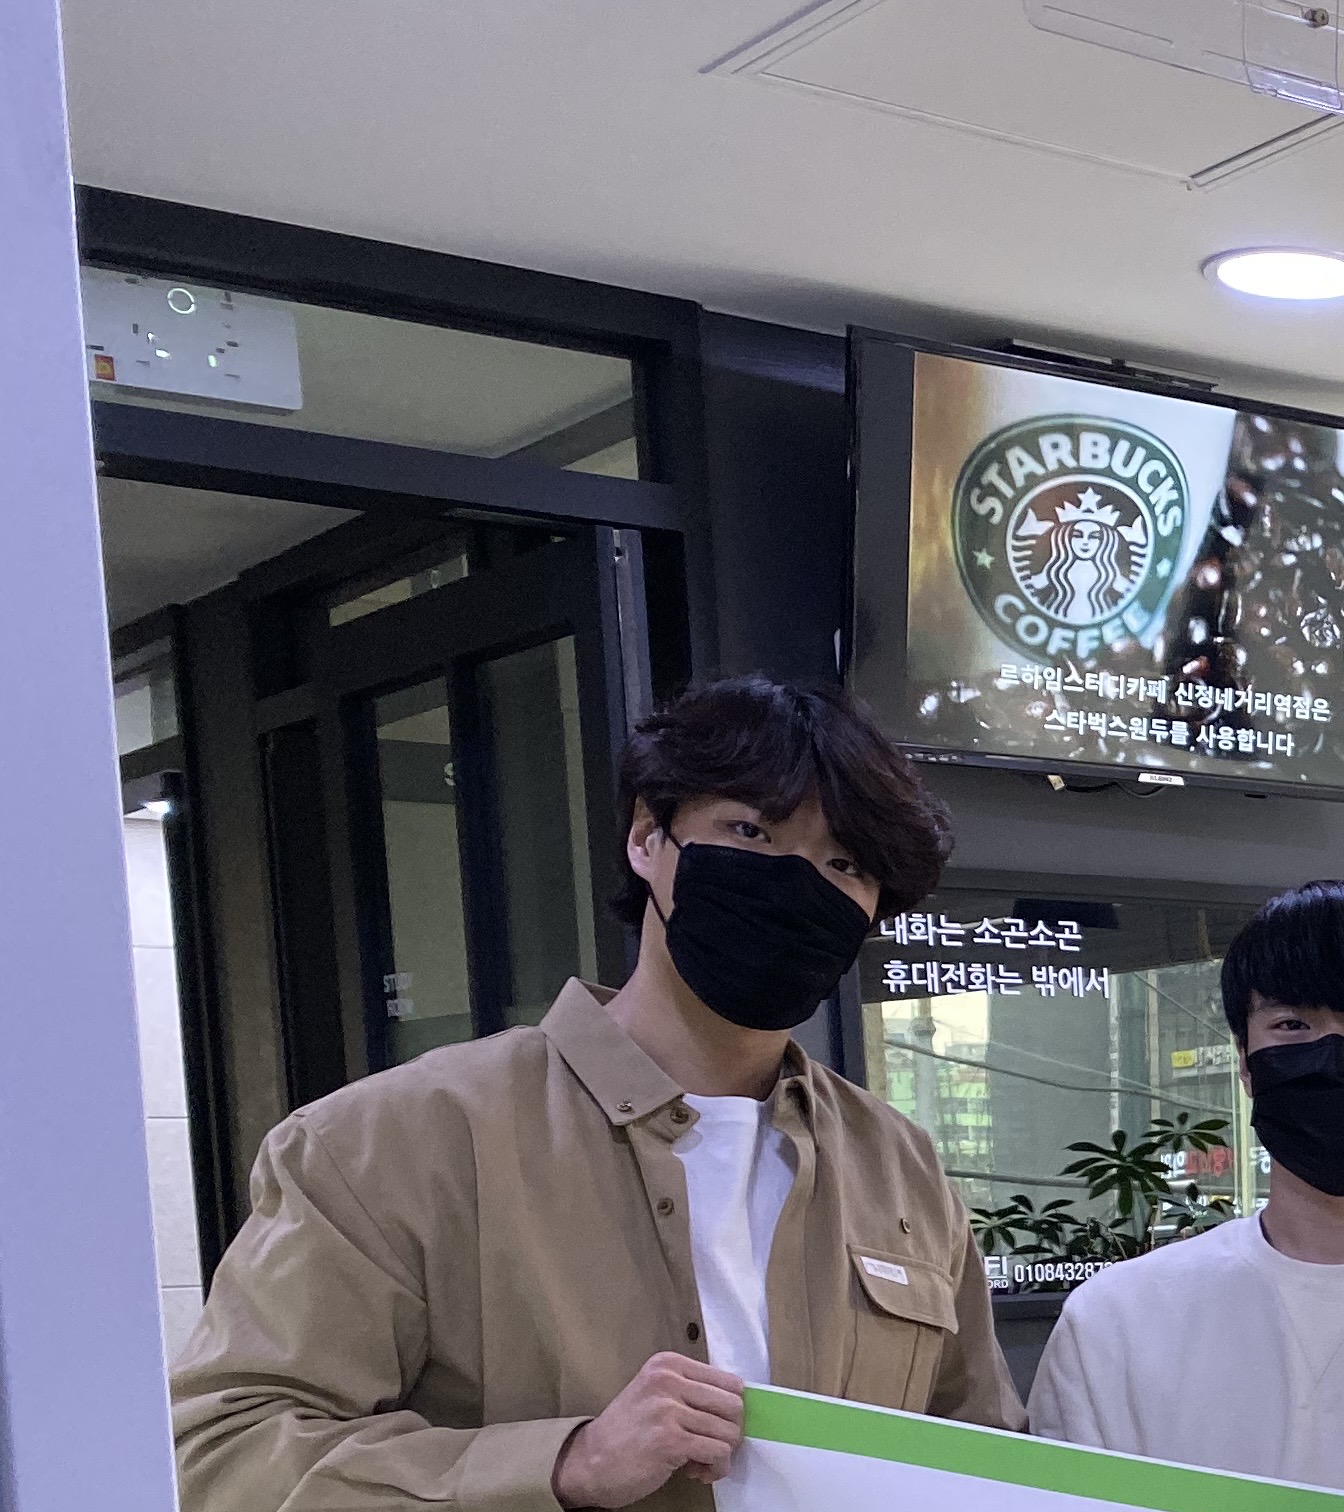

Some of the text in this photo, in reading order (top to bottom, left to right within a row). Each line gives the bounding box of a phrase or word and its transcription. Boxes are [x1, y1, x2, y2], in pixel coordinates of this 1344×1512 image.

[969, 431, 1183, 537] STARBUCKS
[999, 663, 1332, 722] 르하임스터디카페 신정네거리역점은
[1043, 709, 1296, 757] 스타벅스원두를 사용합니다
[973, 917, 1083, 952] 소곤소곤
[882, 959, 1110, 999] 휴대전화는 밖에서
[983, 1255, 1008, 1276] FI
